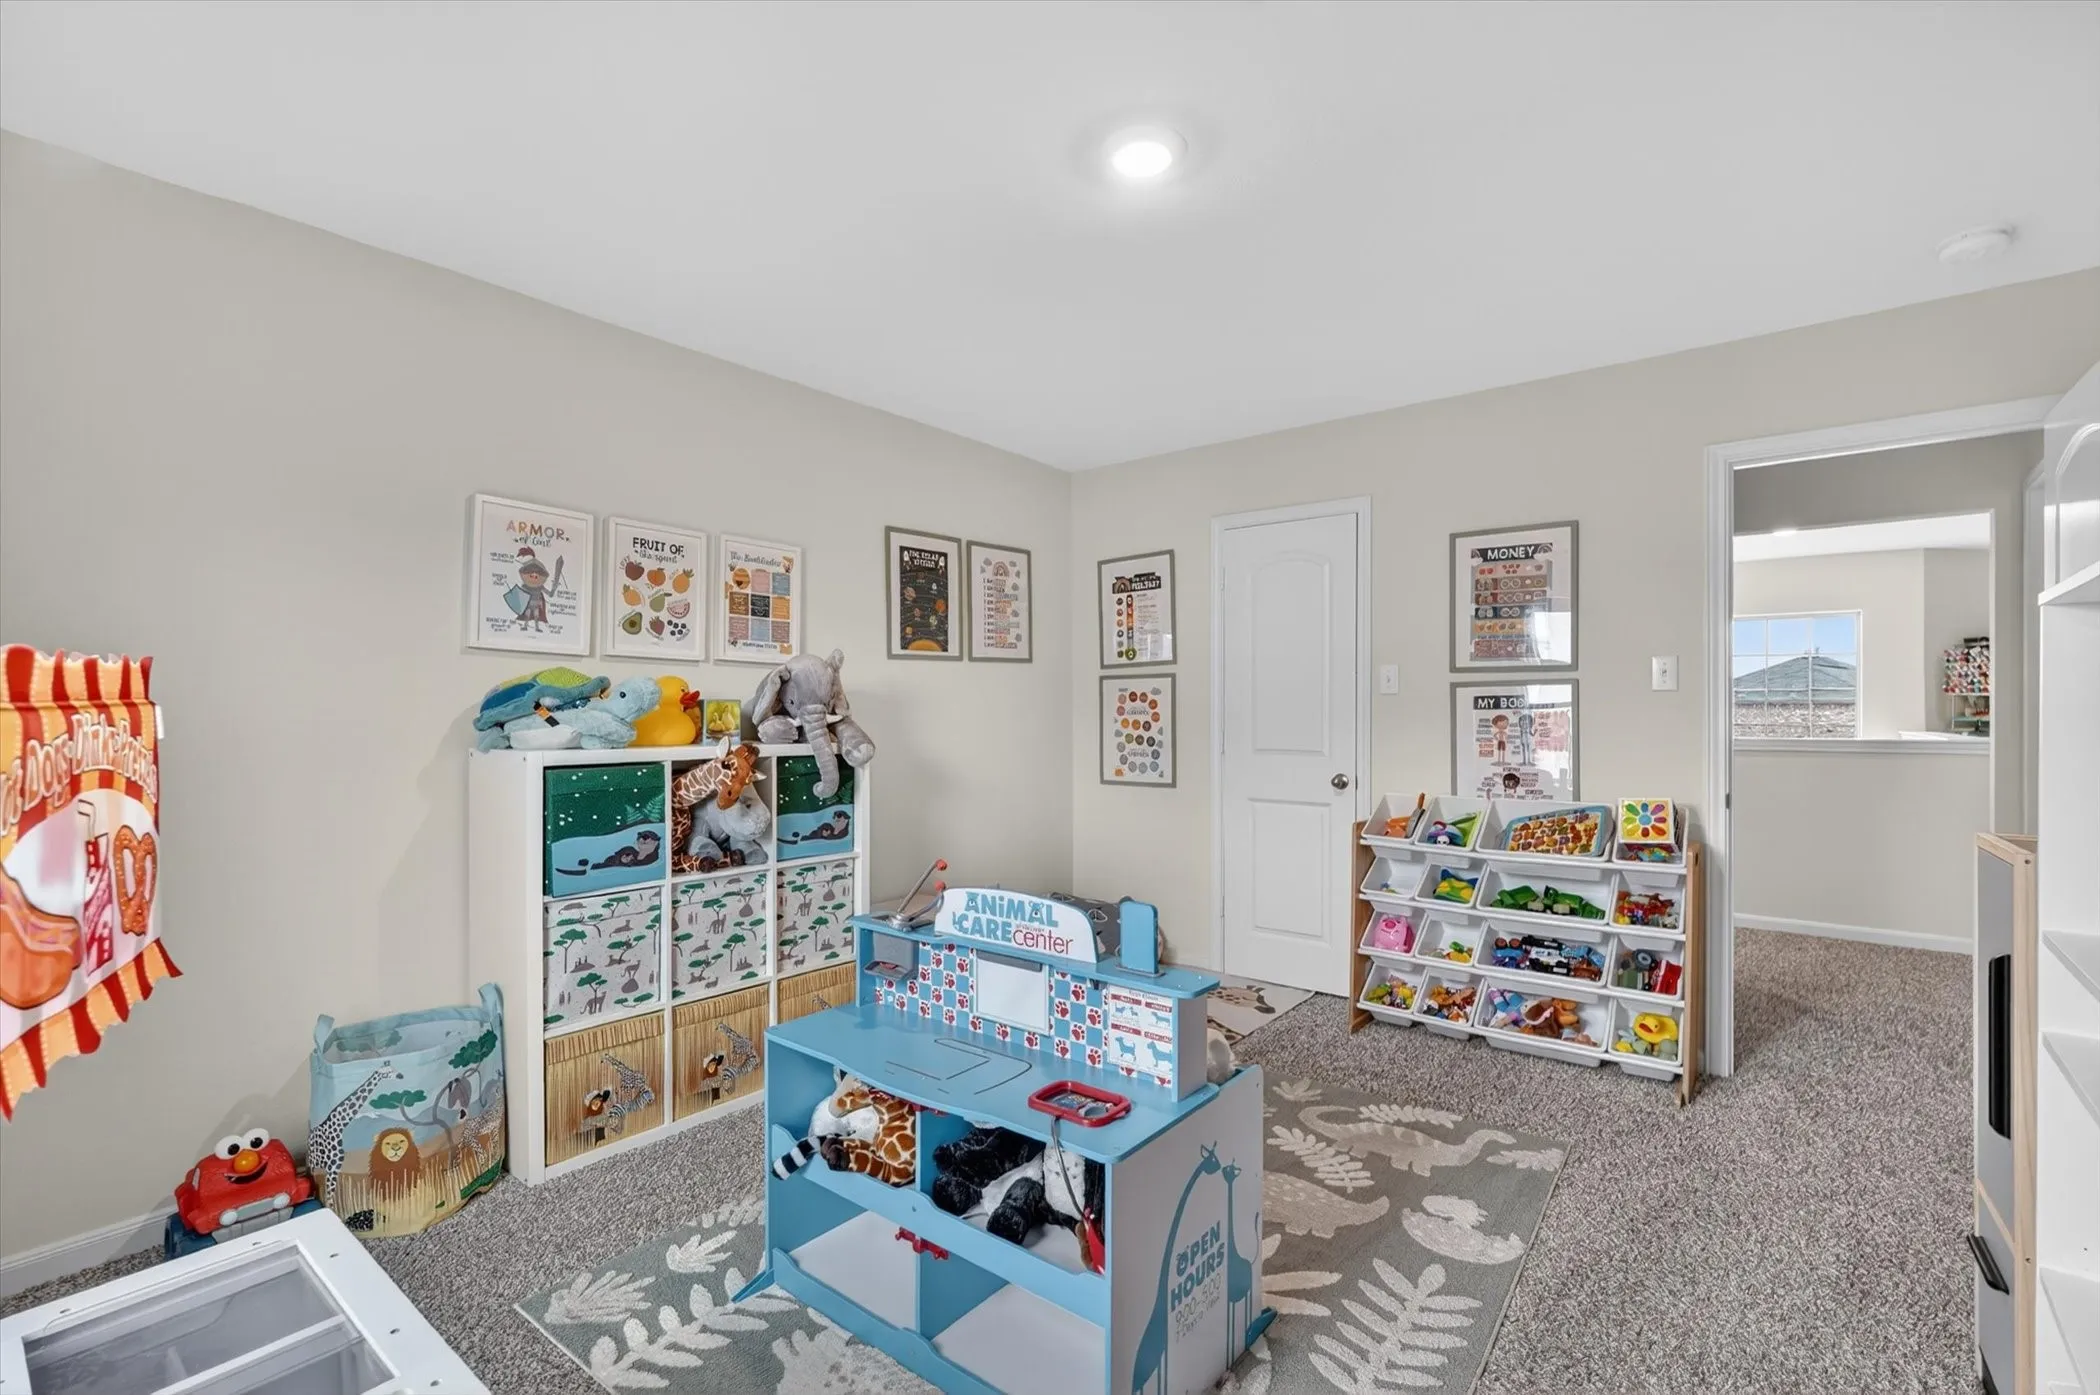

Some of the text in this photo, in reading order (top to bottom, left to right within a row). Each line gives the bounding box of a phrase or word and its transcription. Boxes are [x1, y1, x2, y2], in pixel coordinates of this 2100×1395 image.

[506, 520, 565, 540] ARMOR
[632, 537, 685, 556] FRUIT OF
[1487, 545, 1535, 560] MONEY
[1477, 697, 1496, 709] MY
[1500, 697, 1526, 709] BOD
[23, 732, 71, 812] Dogs
[953, 912, 1013, 943] CARE
[1013, 929, 1074, 955] center
[1176, 1219, 1220, 1277] OPEN
[1170, 1242, 1225, 1312] HOURS
